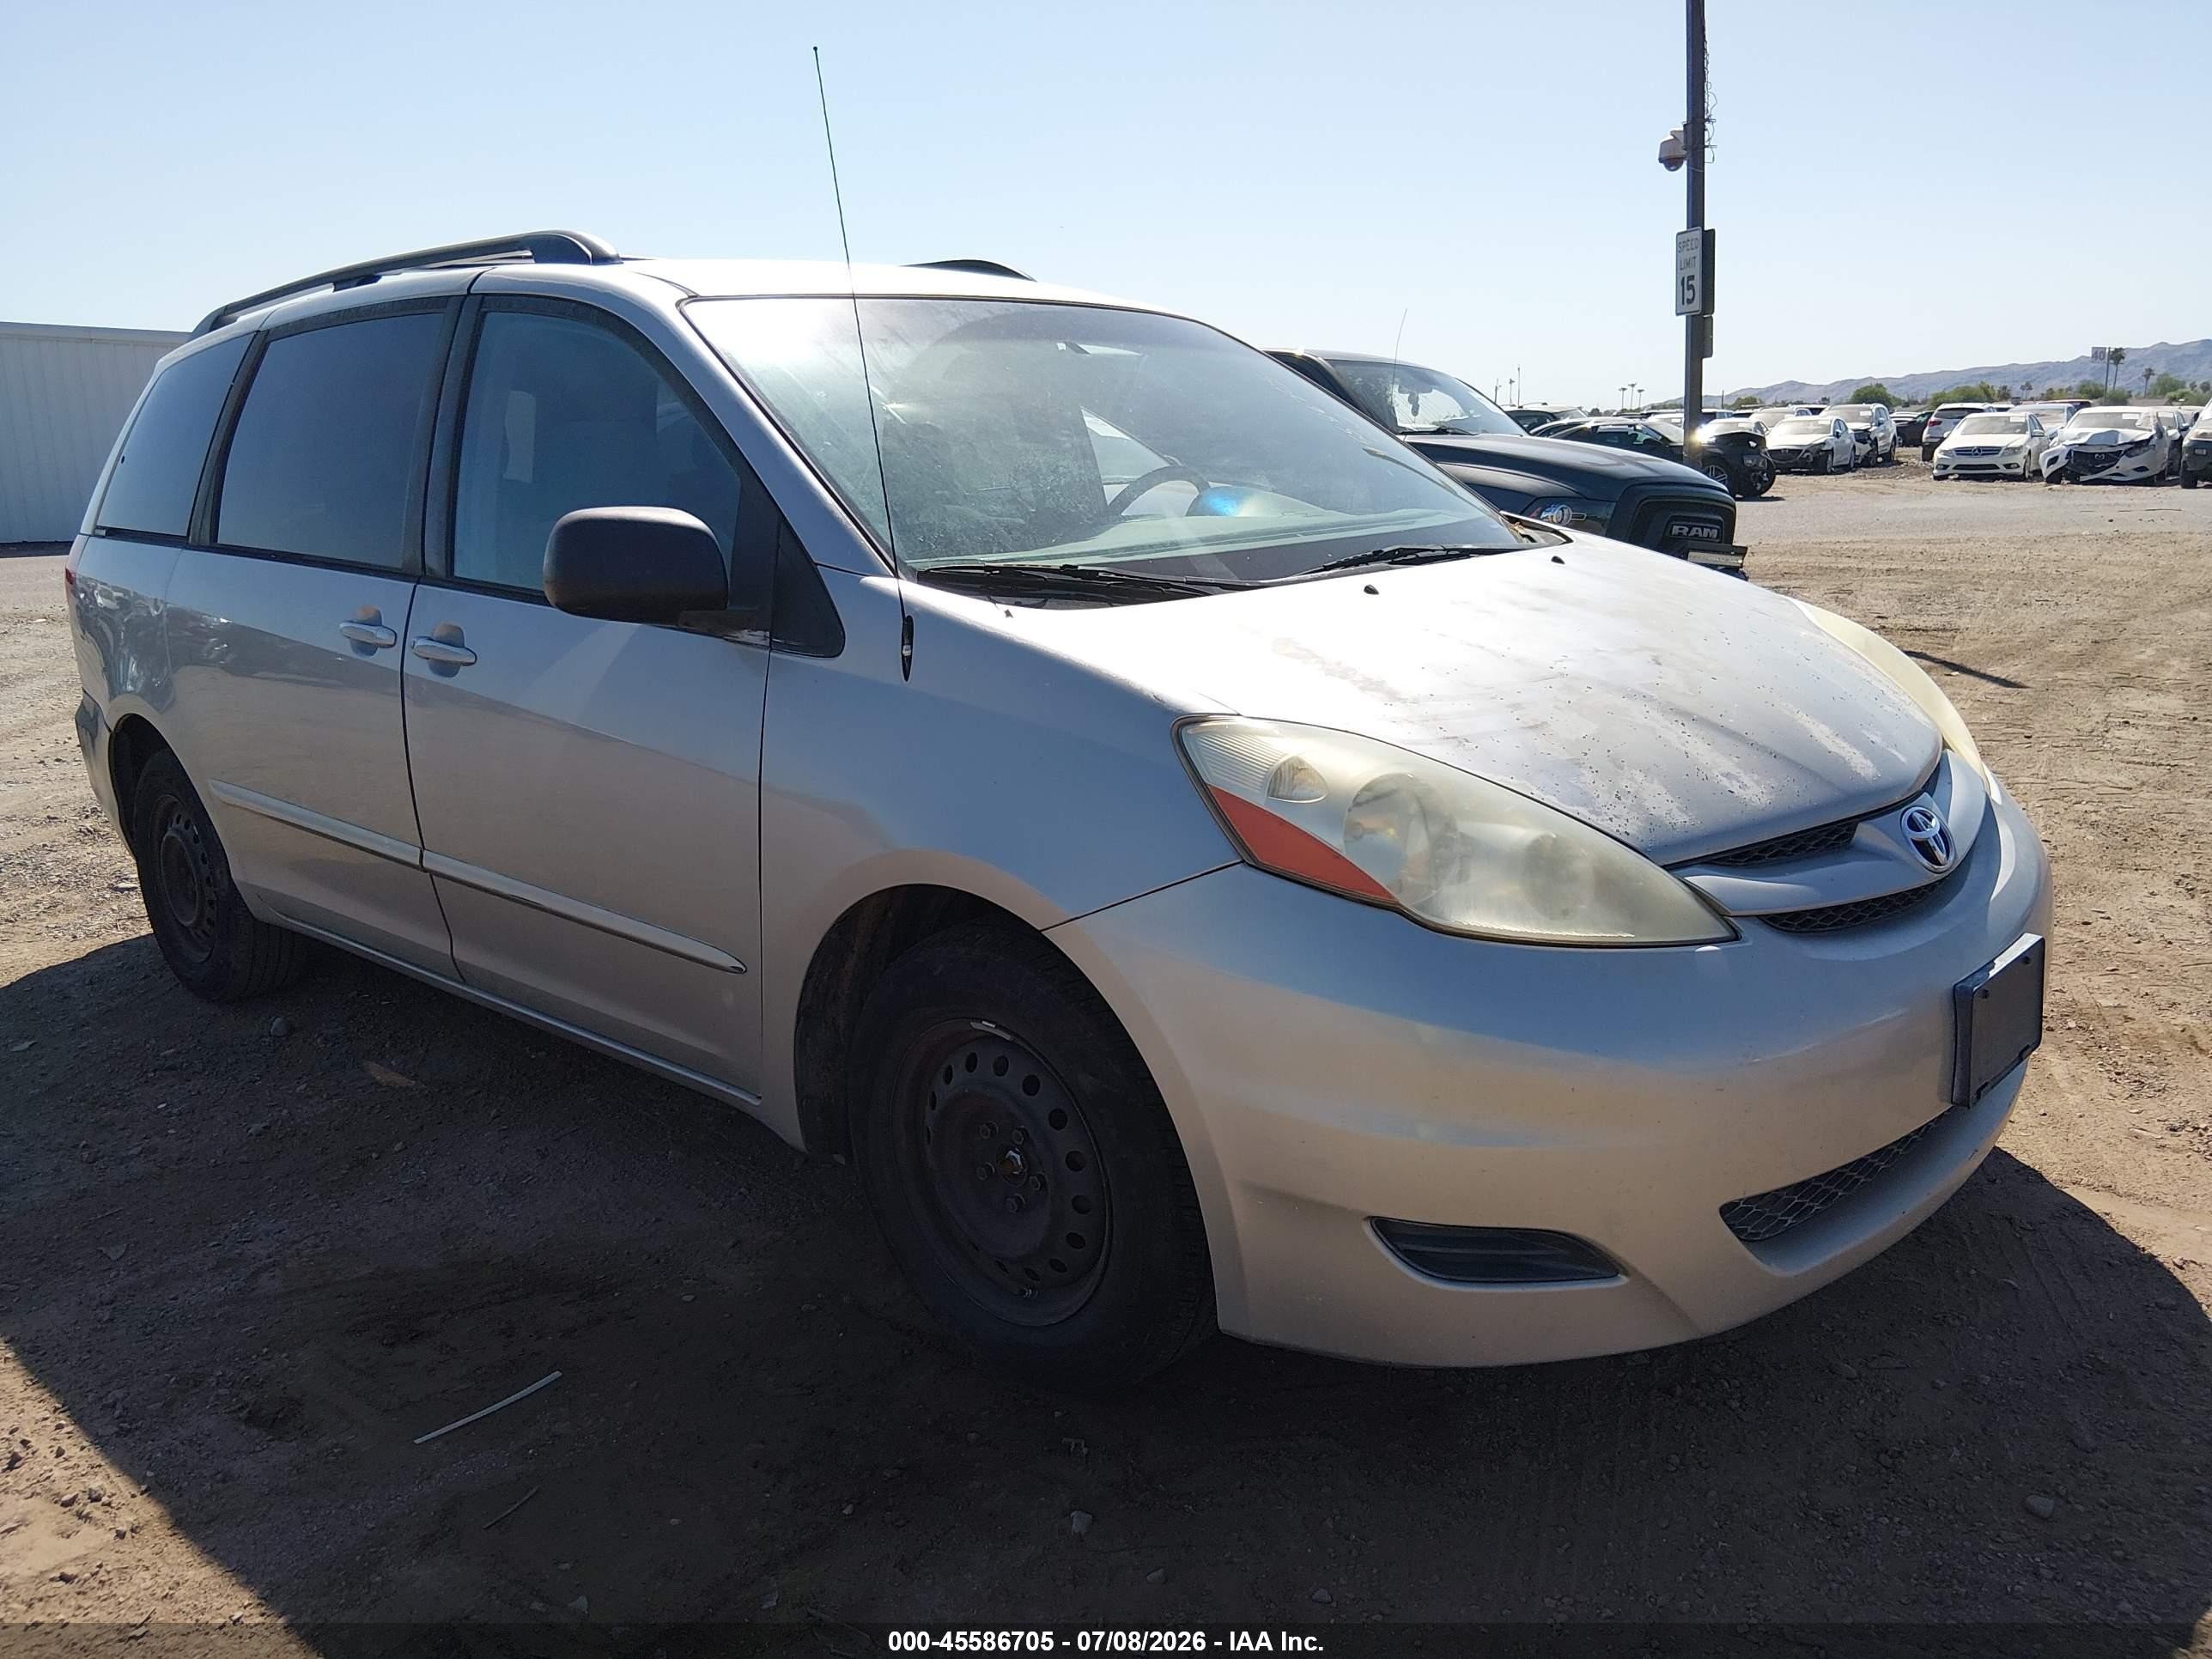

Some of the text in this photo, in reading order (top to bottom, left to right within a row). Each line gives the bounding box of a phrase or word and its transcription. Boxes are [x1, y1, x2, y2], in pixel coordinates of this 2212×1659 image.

[1678, 237, 1699, 253] SPEED
[1680, 256, 1697, 270] LIMIT
[1680, 275, 1696, 306] 15
[1671, 525, 1718, 538] RAM
